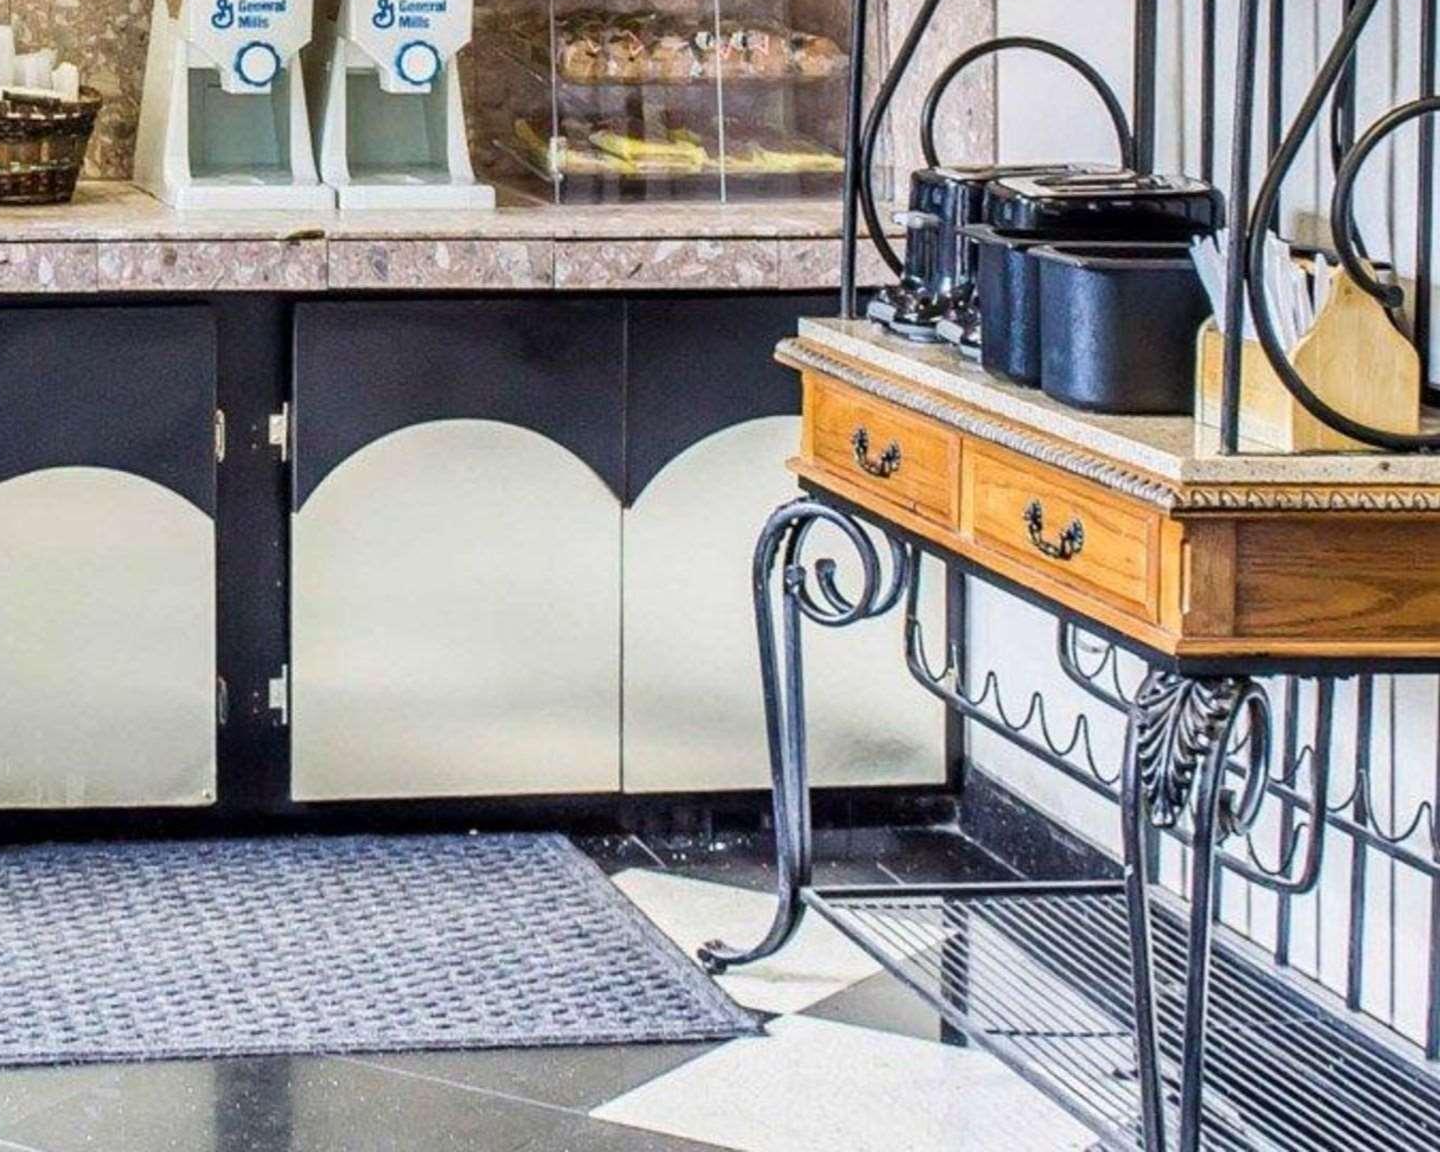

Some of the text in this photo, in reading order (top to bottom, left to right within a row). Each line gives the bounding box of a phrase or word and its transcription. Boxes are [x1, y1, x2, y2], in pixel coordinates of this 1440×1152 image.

[238, 0, 287, 12] General
[398, 0, 447, 12] General
[238, 15, 270, 29] Mills
[398, 15, 430, 29] Mills
